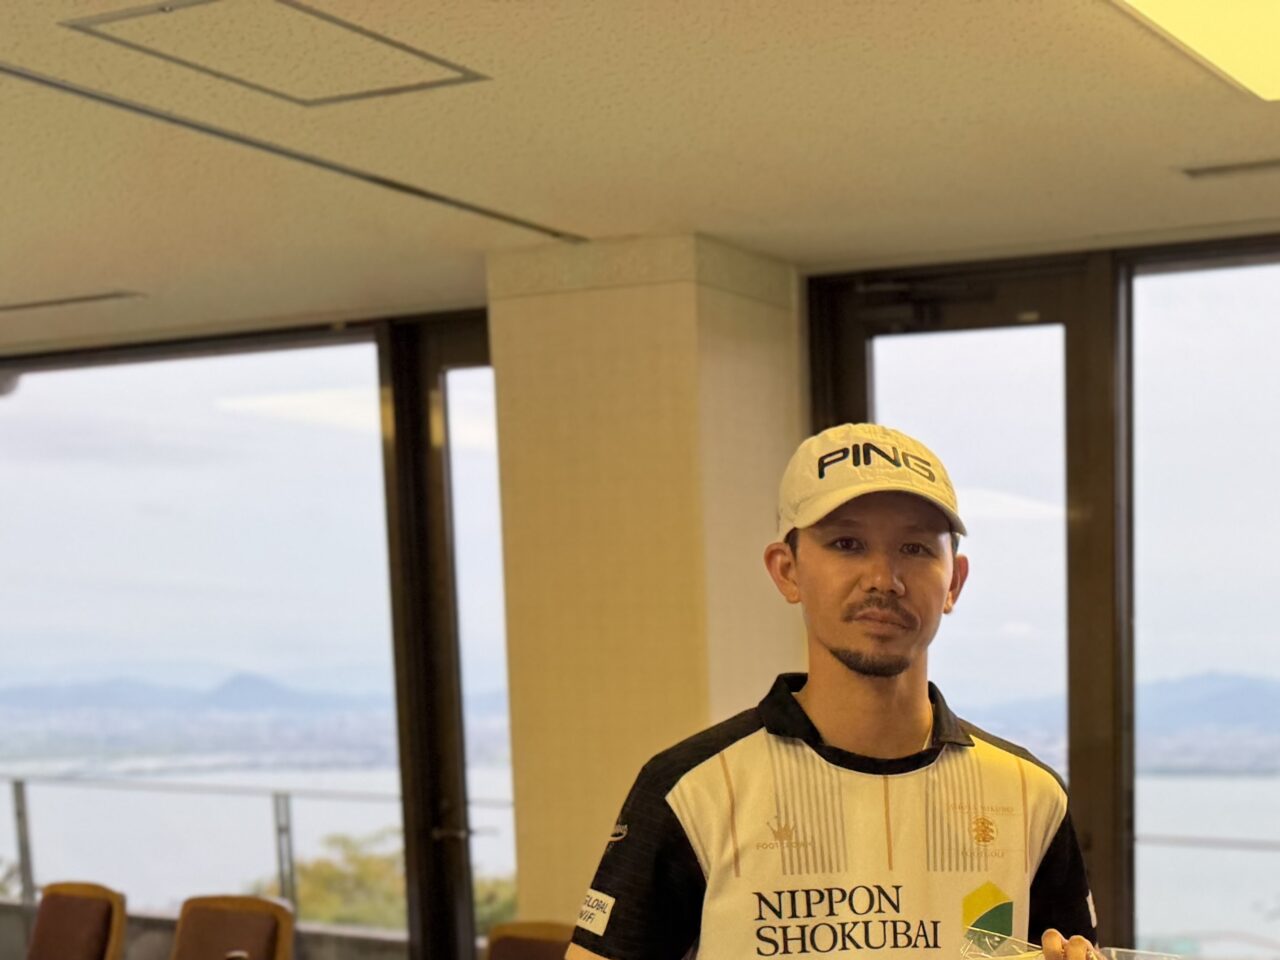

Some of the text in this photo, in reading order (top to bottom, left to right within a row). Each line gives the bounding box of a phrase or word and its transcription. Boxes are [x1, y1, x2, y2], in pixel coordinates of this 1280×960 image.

[818, 442, 936, 483] PING
[752, 885, 903, 921] NIPPON
[756, 920, 942, 957] SHOKUBAI
